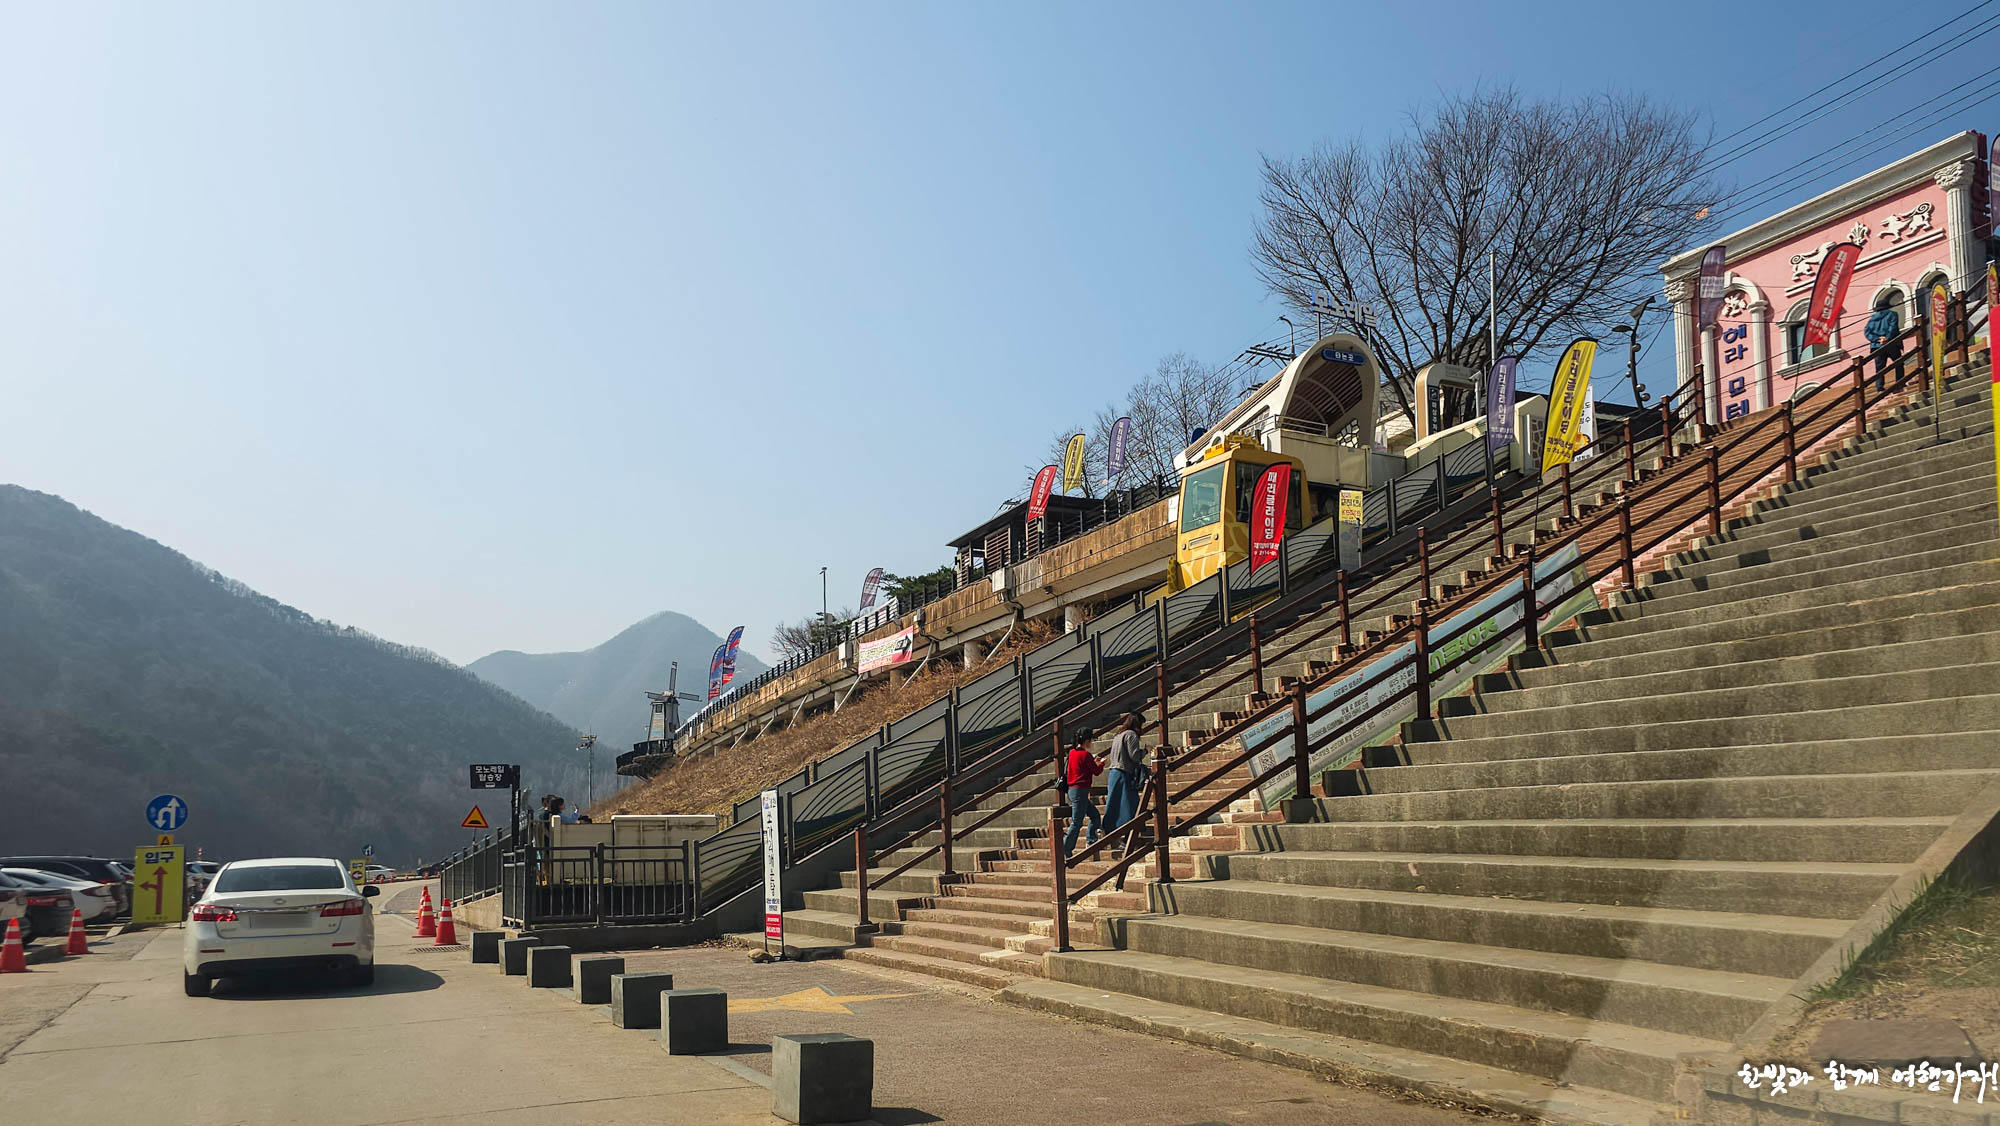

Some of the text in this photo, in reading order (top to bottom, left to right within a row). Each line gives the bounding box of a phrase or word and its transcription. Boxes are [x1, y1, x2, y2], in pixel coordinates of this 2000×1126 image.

[1311, 290, 1378, 328] 모노레일
[1723, 324, 1748, 364] 헤라
[1560, 349, 1581, 434] 패러글라이딩
[1264, 471, 1278, 540] 패러글라이딩
[475, 765, 505, 774] 모노레일
[478, 773, 502, 782] 탑승장
[145, 851, 175, 864] 입구
